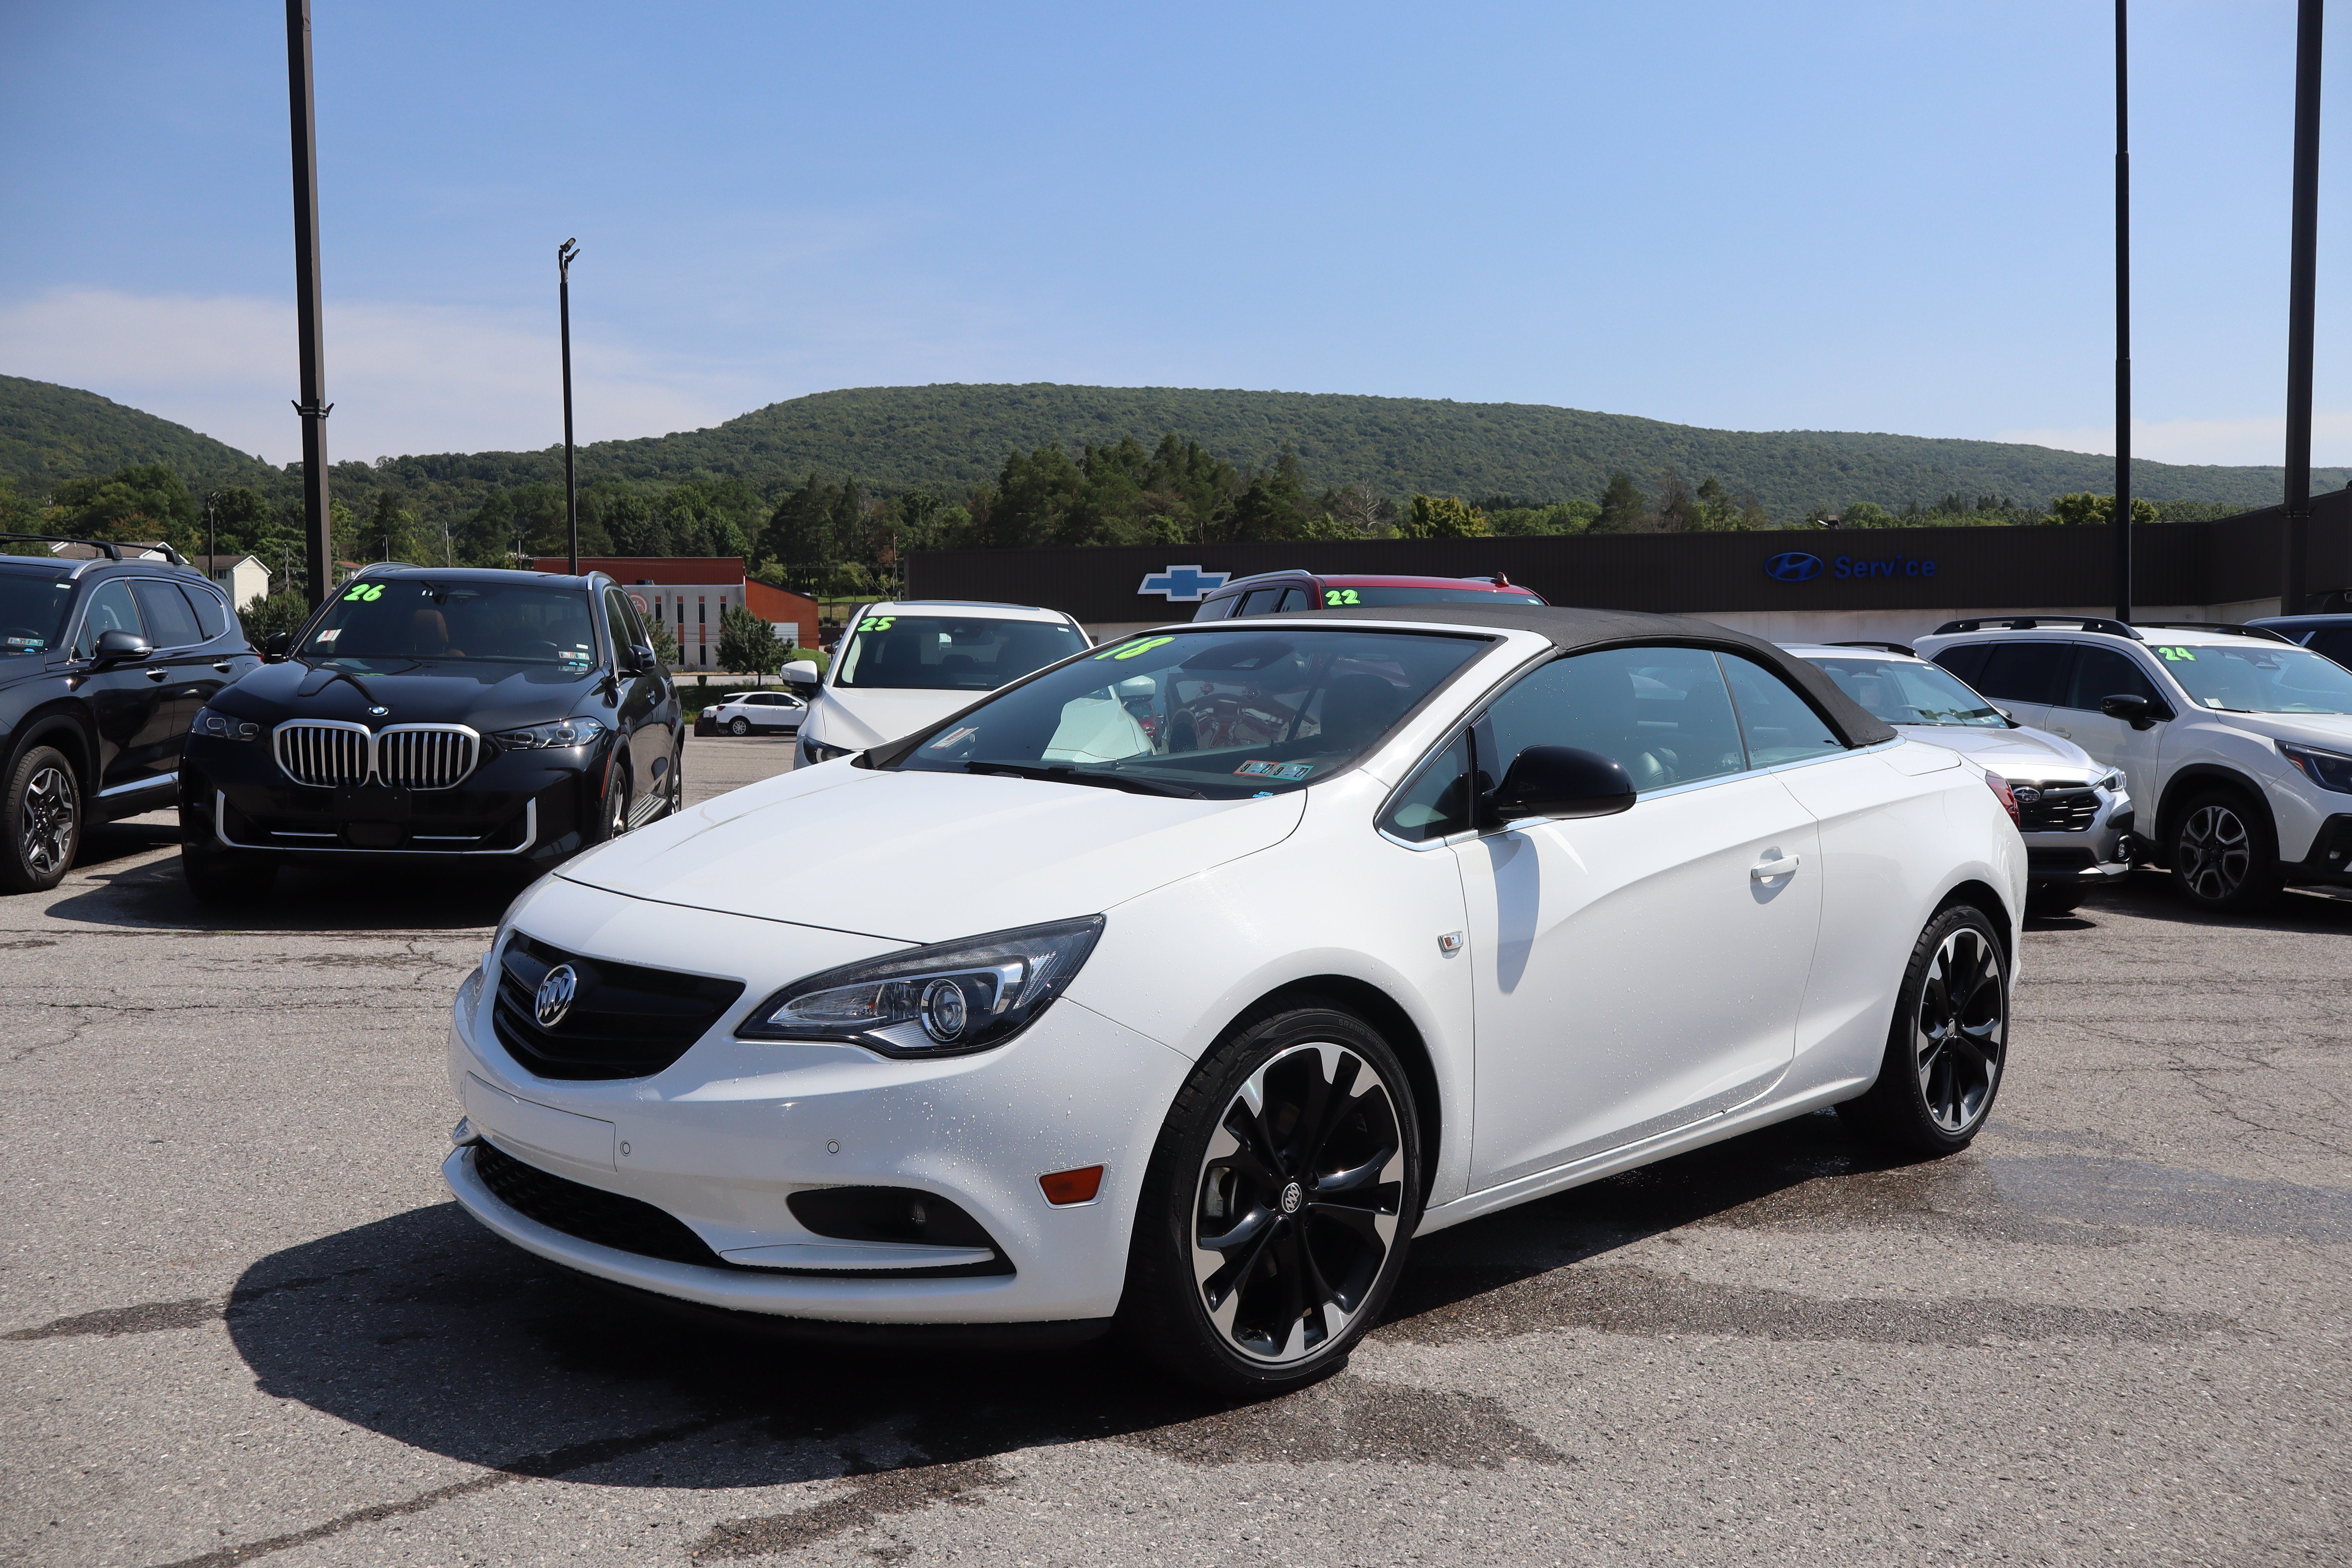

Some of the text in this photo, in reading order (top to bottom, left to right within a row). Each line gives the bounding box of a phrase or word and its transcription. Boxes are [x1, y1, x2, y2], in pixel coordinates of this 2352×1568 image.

[1834, 555, 1937, 578] Service
[344, 584, 386, 602] 26
[1325, 589, 1361, 606] 22
[858, 617, 896, 632] 25
[1094, 637, 1176, 660] 18
[2158, 647, 2197, 661] 24
[1240, 764, 1275, 774] 9 27
[1273, 767, 1309, 778] 9 27
[1339, 1019, 1365, 1036] GRAND
[1367, 1033, 1388, 1056] SPORT
